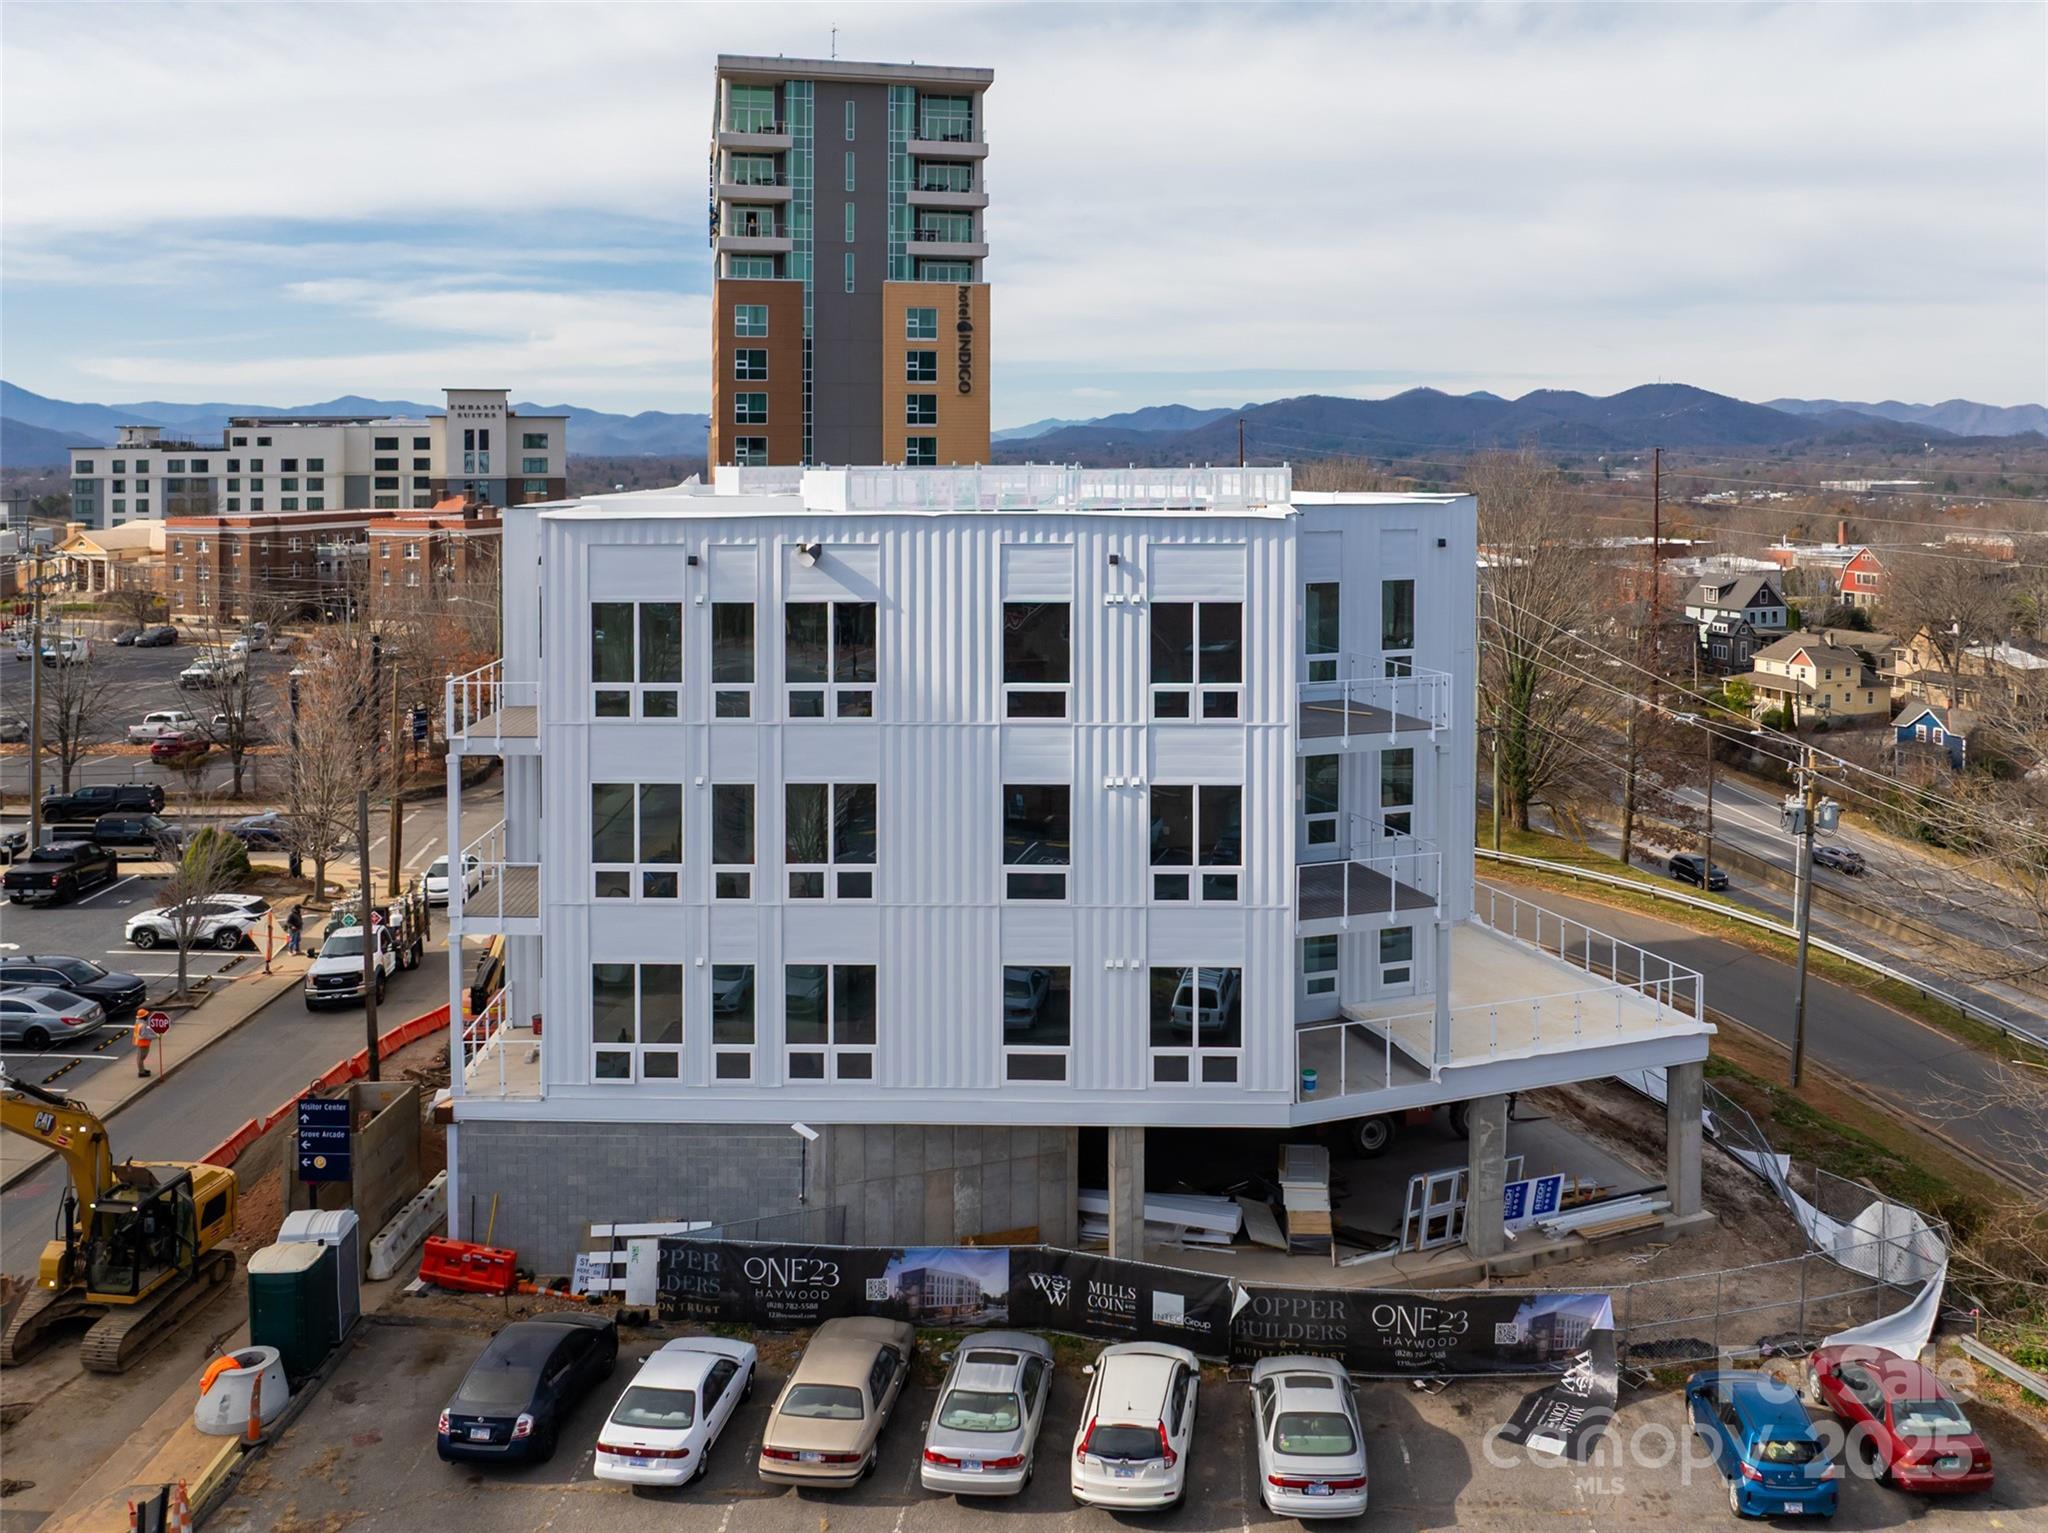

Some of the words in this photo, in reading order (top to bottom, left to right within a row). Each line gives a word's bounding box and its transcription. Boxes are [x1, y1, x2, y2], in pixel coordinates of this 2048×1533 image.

[958, 286, 971, 320] hotel
[958, 334, 971, 393] INDIGO
[150, 1018, 169, 1028] STOP
[300, 1103, 322, 1111] Visitor
[323, 1103, 346, 1111] Center
[34, 1112, 54, 1131] CAT
[300, 1130, 320, 1138] Grove
[321, 1130, 345, 1138] Arcade
[744, 1257, 840, 1288] ONE23
[755, 1289, 830, 1300] HAYWOOD
[1088, 1280, 1136, 1300] MILLS
[680, 1303, 720, 1314] TRUST
[1087, 1294, 1124, 1312] COIN
[1184, 1316, 1211, 1329] Group
[1372, 1304, 1469, 1337] ONE23
[1235, 1320, 1347, 1340] BUILDERS
[1383, 1336, 1458, 1349] HAYWOOD
[1560, 1405, 1586, 1434] MILLS
